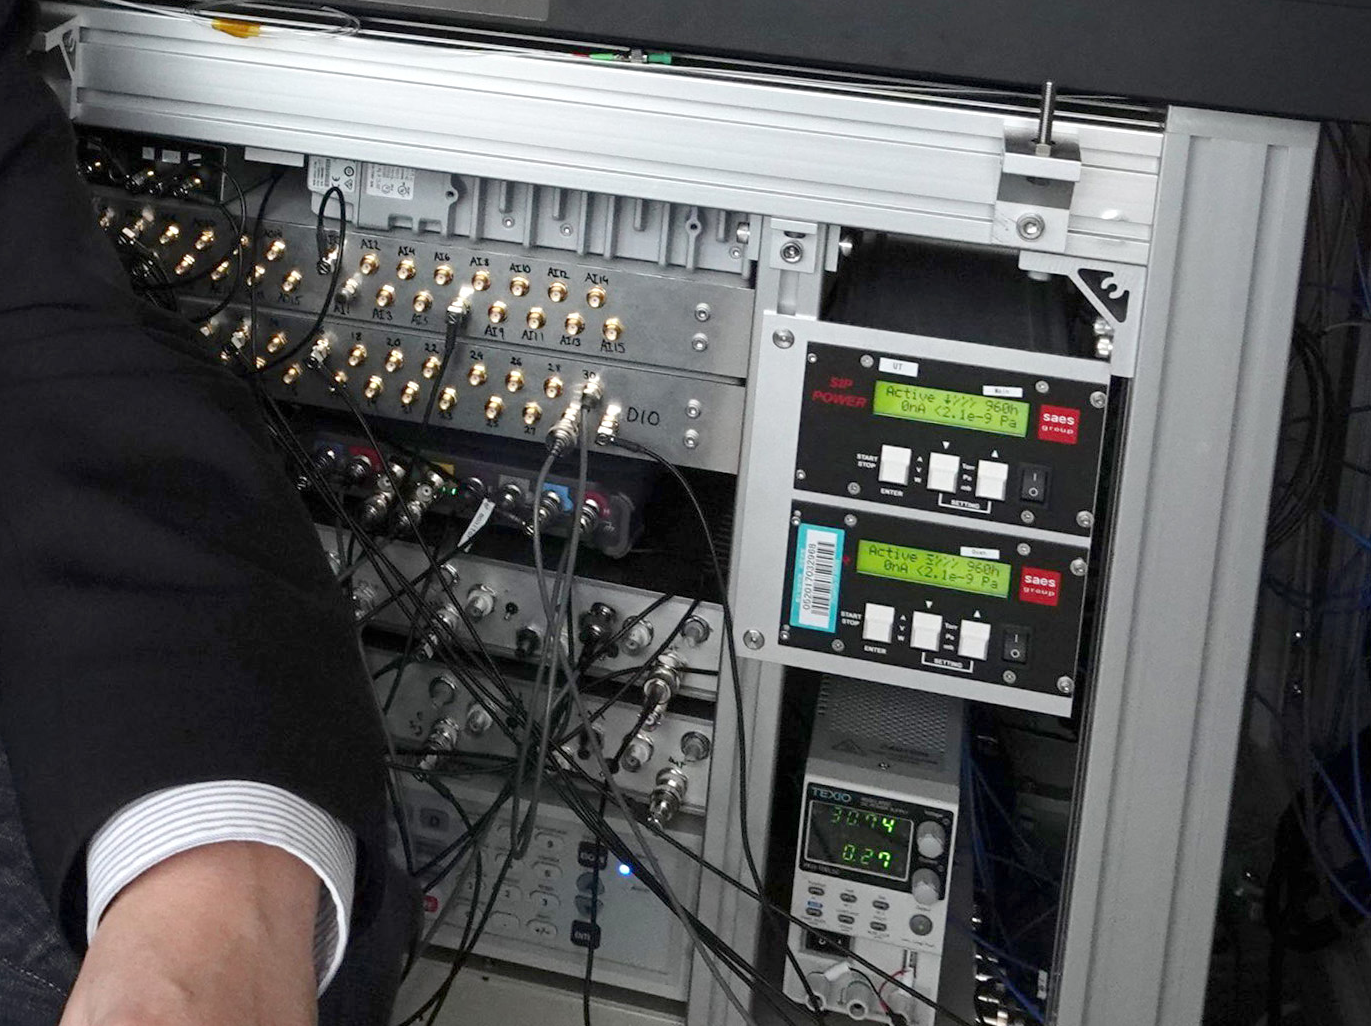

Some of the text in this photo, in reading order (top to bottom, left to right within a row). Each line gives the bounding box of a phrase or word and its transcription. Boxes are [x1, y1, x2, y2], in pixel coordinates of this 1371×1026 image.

[360, 238, 381, 251] AI2
[397, 245, 416, 256] AI4
[433, 251, 451, 262] AI6
[469, 256, 490, 267] AI8
[509, 262, 531, 274] AI10
[585, 272, 609, 285] AI14
[372, 308, 393, 321] AI3
[484, 324, 506, 341] AI9
[386, 337, 401, 346] 20
[559, 335, 581, 347] AI13
[600, 339, 626, 354] AI15
[424, 342, 439, 354] 22
[581, 369, 596, 379] 30
[812, 391, 867, 409] POWER
[886, 385, 936, 403] Active
[999, 415, 1017, 429] Pa
[1042, 414, 1075, 426] saes
[1041, 425, 1074, 435] group
[856, 453, 879, 462] START
[857, 461, 877, 469] STOP
[880, 488, 904, 497] ENTER
[950, 500, 980, 510] SETTING
[868, 544, 918, 562] Active
[980, 576, 998, 589] Pa
[1024, 575, 1056, 587] saes
[1023, 586, 1055, 597] group
[840, 611, 862, 620] START
[841, 618, 861, 627] STOP
[864, 645, 887, 655] ENTER
[933, 658, 963, 669] SETTING
[811, 787, 853, 803] TEXIO
[842, 844, 892, 868] 0.27
